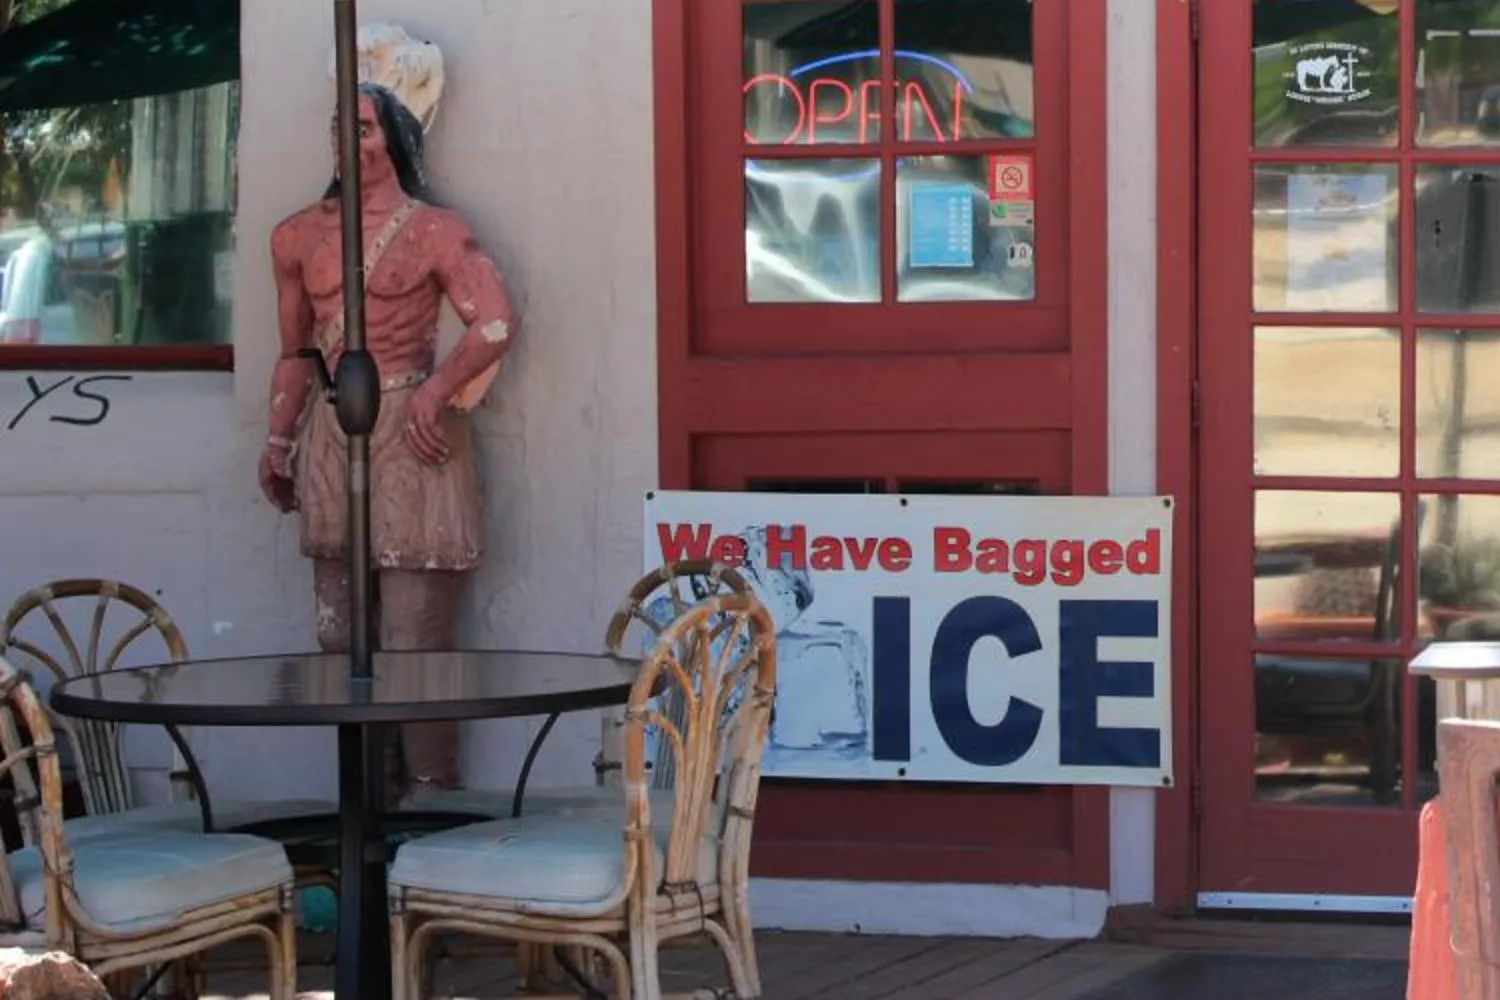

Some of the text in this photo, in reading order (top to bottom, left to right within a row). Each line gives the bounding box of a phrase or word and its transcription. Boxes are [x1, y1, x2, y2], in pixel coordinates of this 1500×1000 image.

[743, 72, 962, 144] OPEN
[657, 522, 1161, 587] We Have Bagged
[872, 595, 1161, 768] ICE
